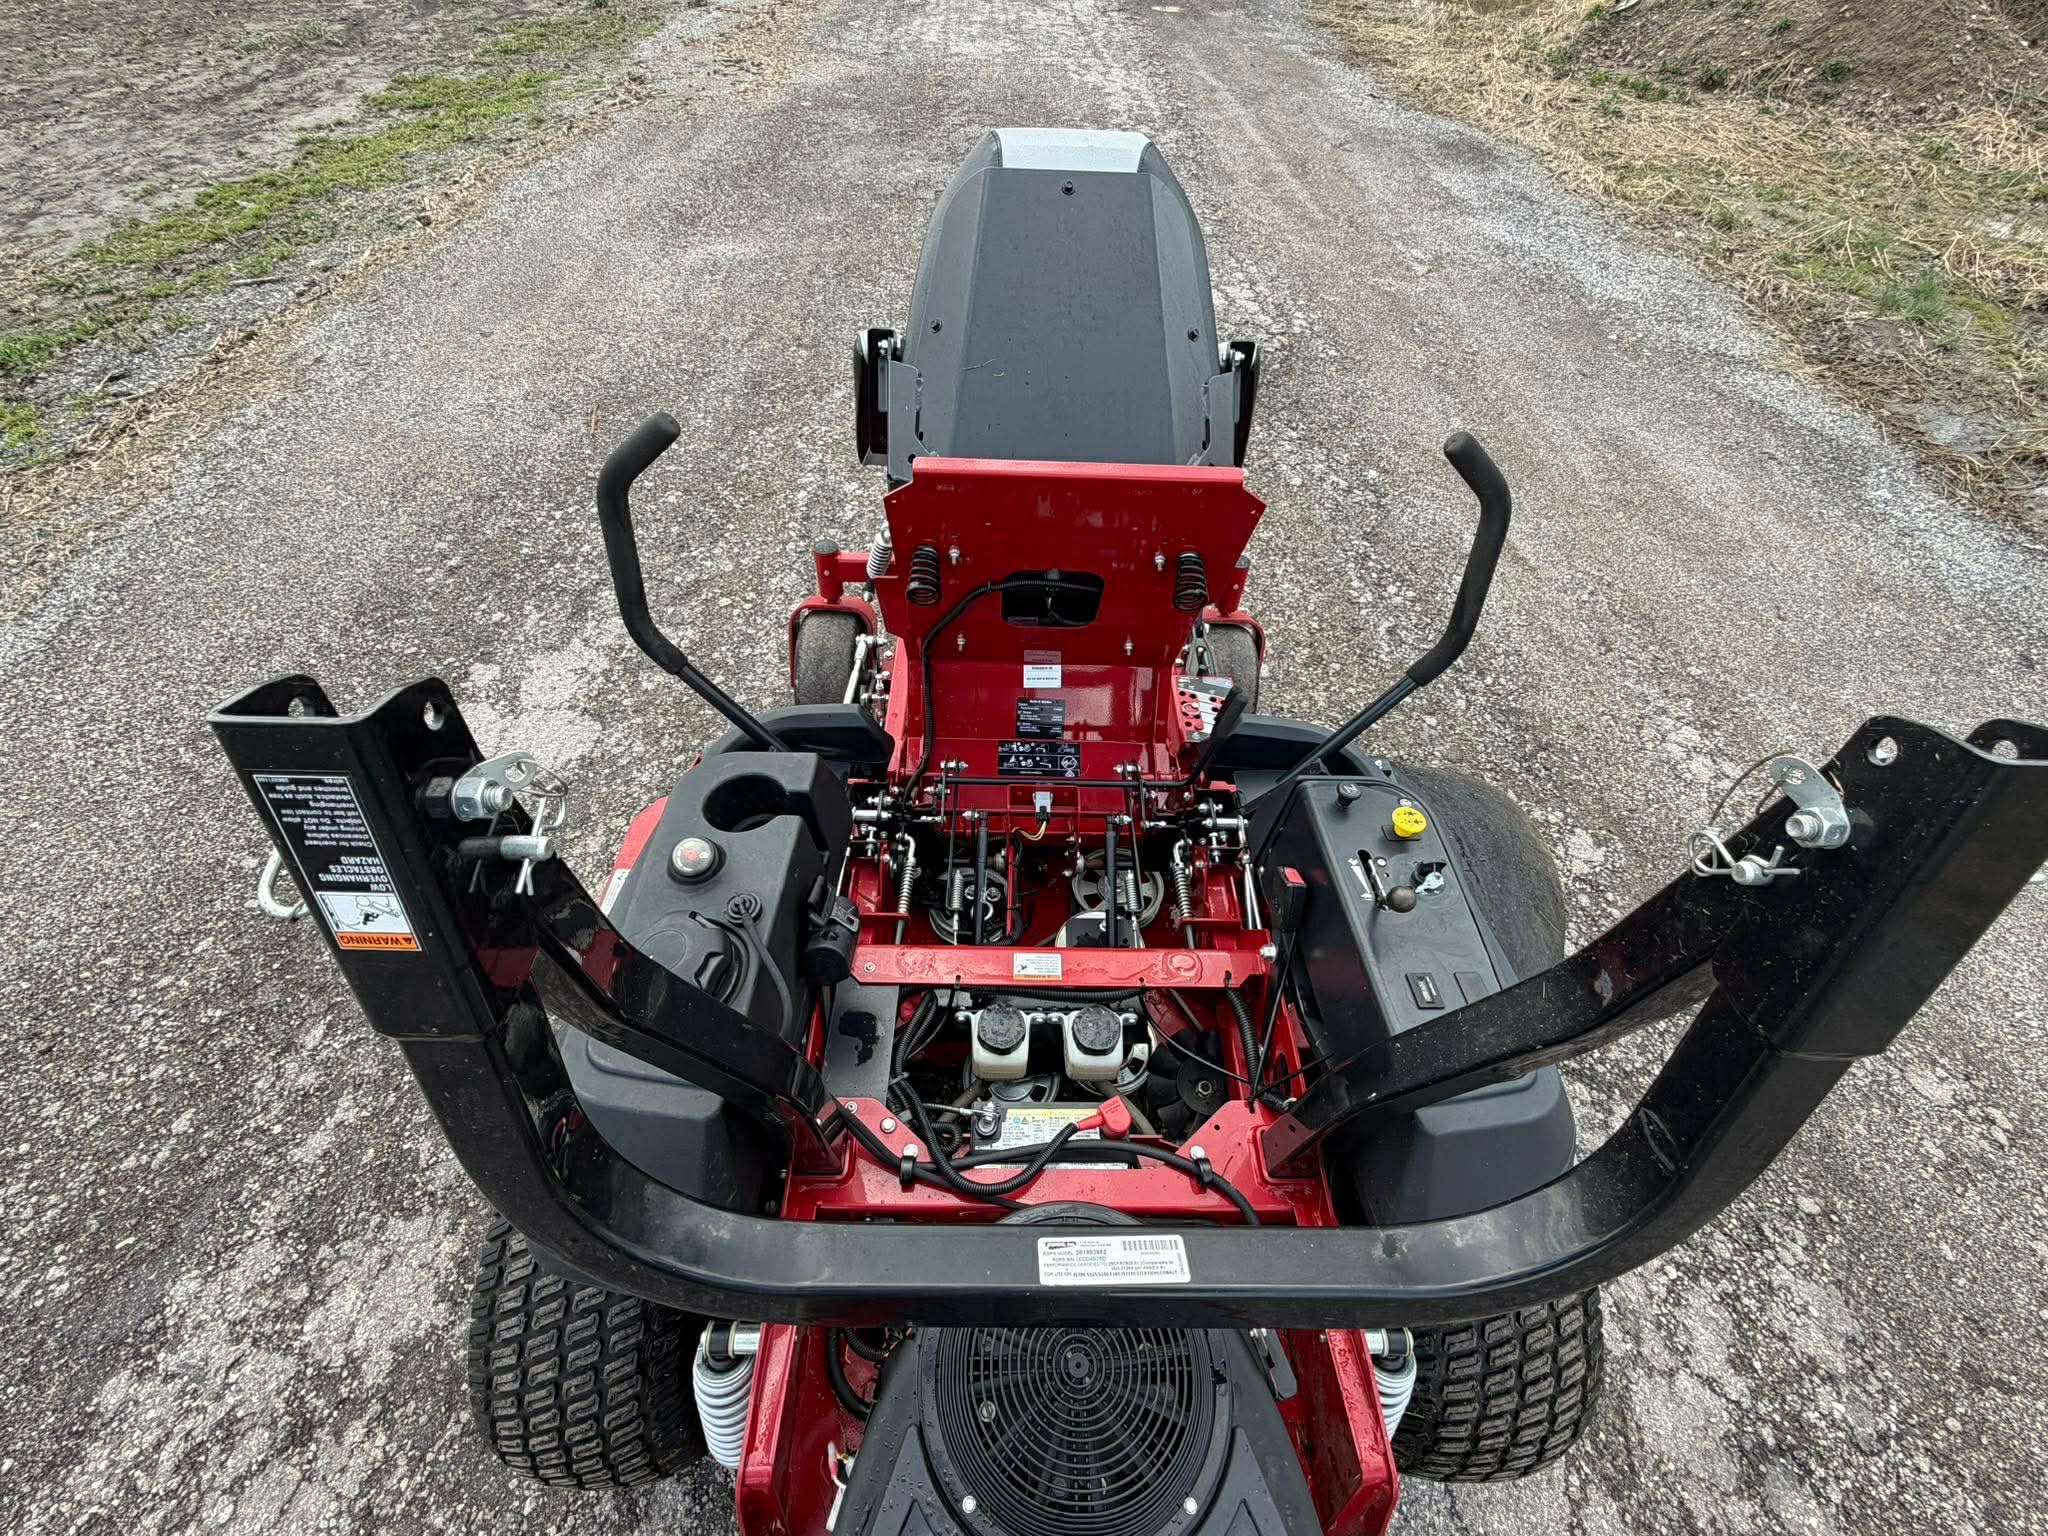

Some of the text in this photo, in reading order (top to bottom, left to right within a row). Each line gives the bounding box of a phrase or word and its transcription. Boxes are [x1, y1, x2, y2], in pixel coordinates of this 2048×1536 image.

[341, 856, 381, 864] HAZARD
[330, 865, 384, 873] OBSTACLES
[320, 873, 388, 882] OVERHANGING
[340, 935, 402, 945] WARNING
